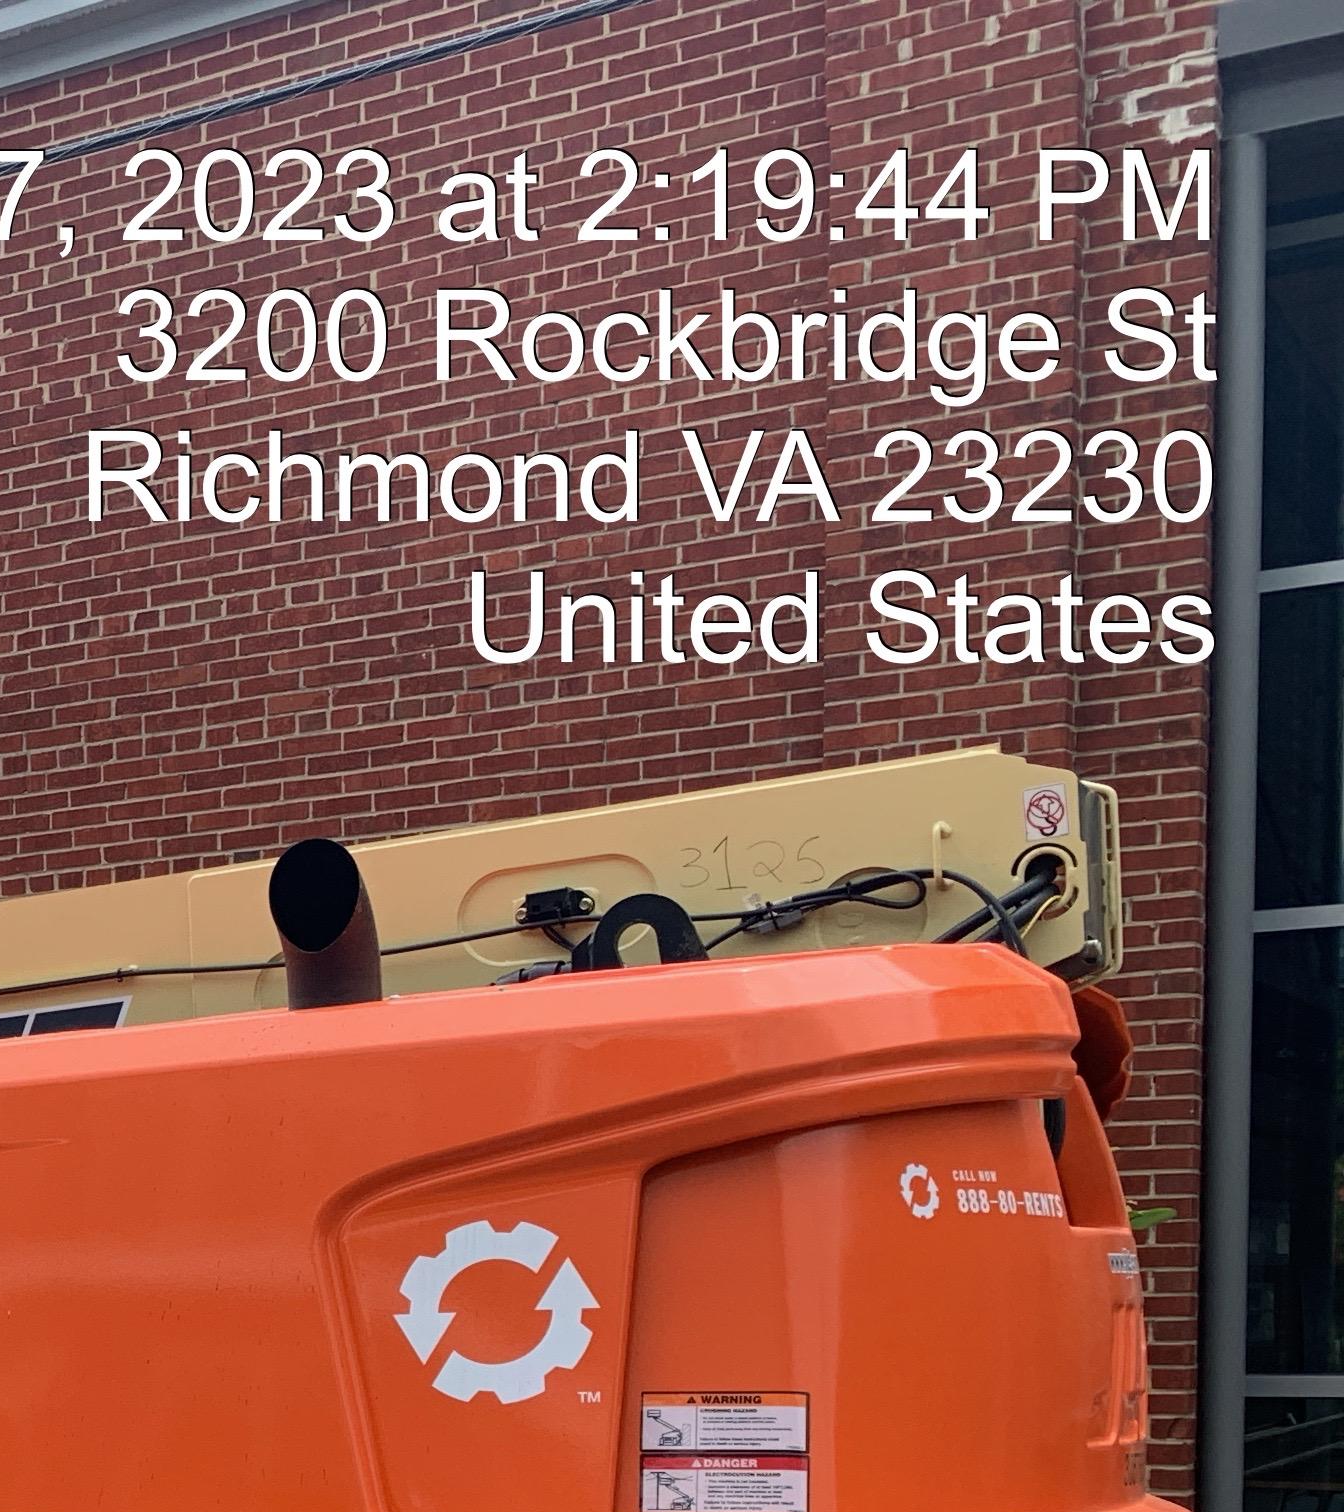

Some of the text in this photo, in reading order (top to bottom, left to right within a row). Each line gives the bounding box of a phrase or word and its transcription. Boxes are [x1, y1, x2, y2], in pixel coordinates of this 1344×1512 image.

[679, 835, 826, 891] 3125
[952, 1169, 976, 1182] CALL
[956, 1188, 1064, 1218] 888-80-RENTS
[576, 1391, 601, 1404] TM
[700, 1395, 763, 1405] WARNING
[703, 1458, 758, 1468] DANGER
